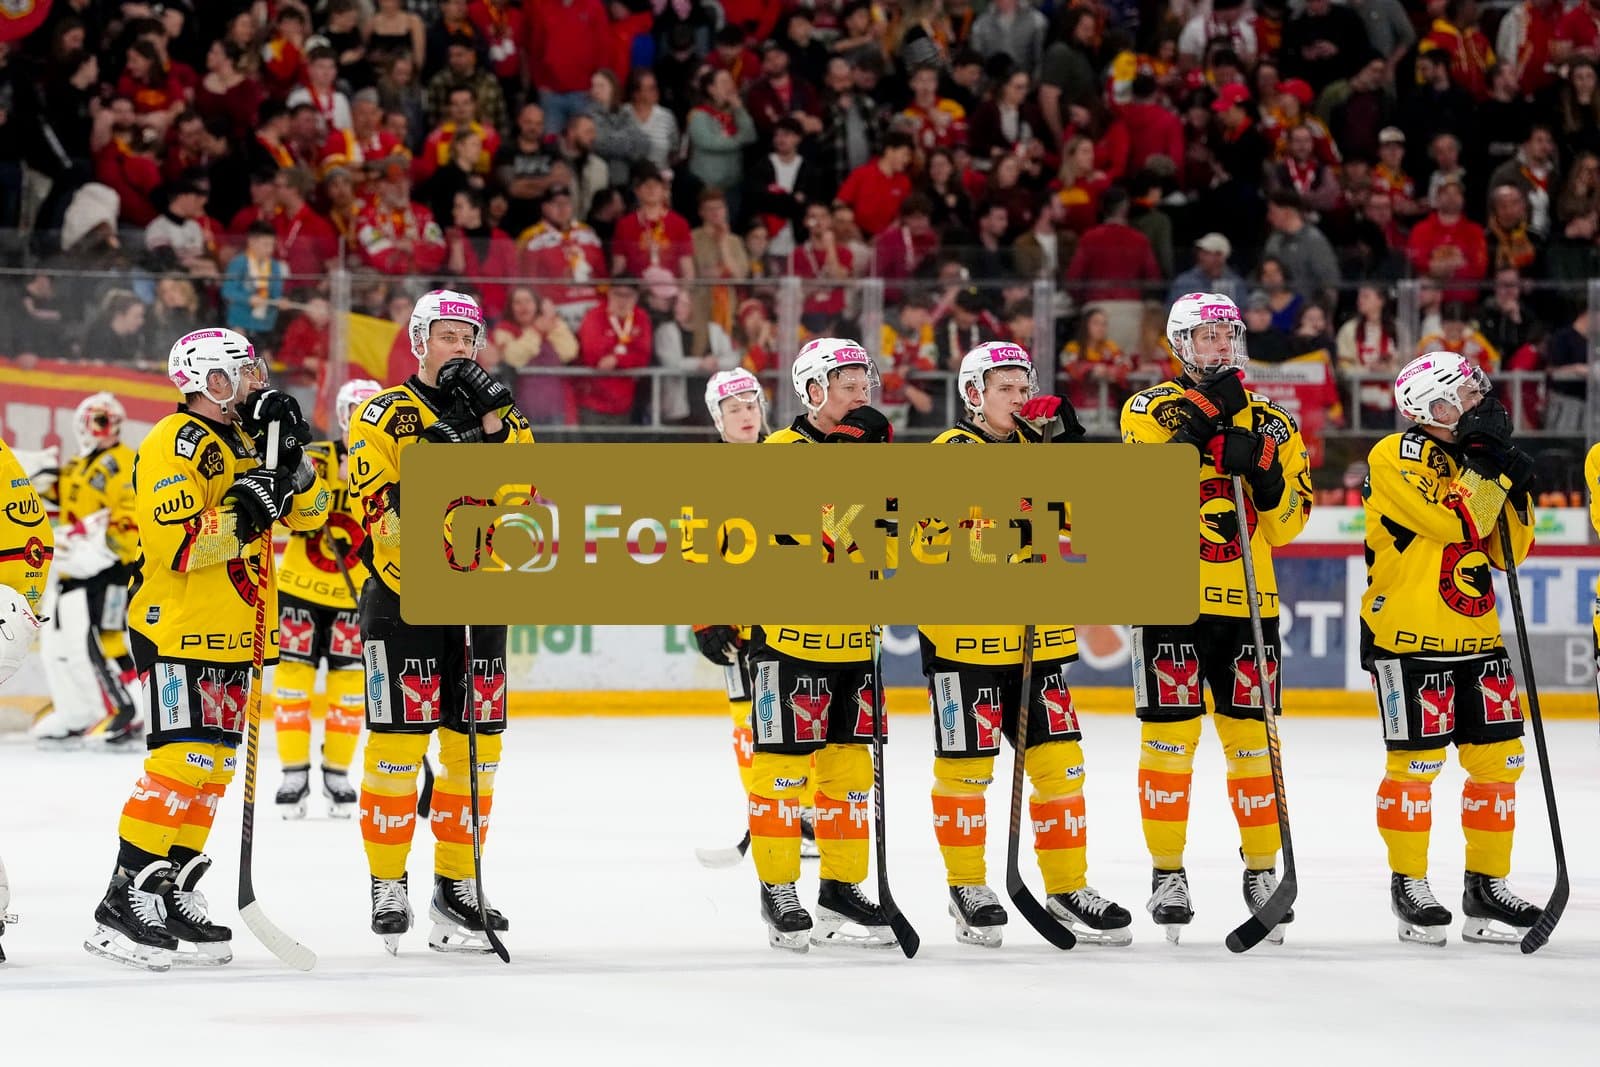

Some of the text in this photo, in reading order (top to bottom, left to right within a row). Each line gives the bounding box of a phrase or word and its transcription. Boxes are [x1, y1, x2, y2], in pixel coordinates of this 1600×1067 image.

[3, 493, 43, 520] ewb
[153, 489, 197, 524] ewb
[1145, 780, 1185, 810] hrs
[1237, 788, 1276, 817] hrs
[372, 805, 415, 834] hrs
